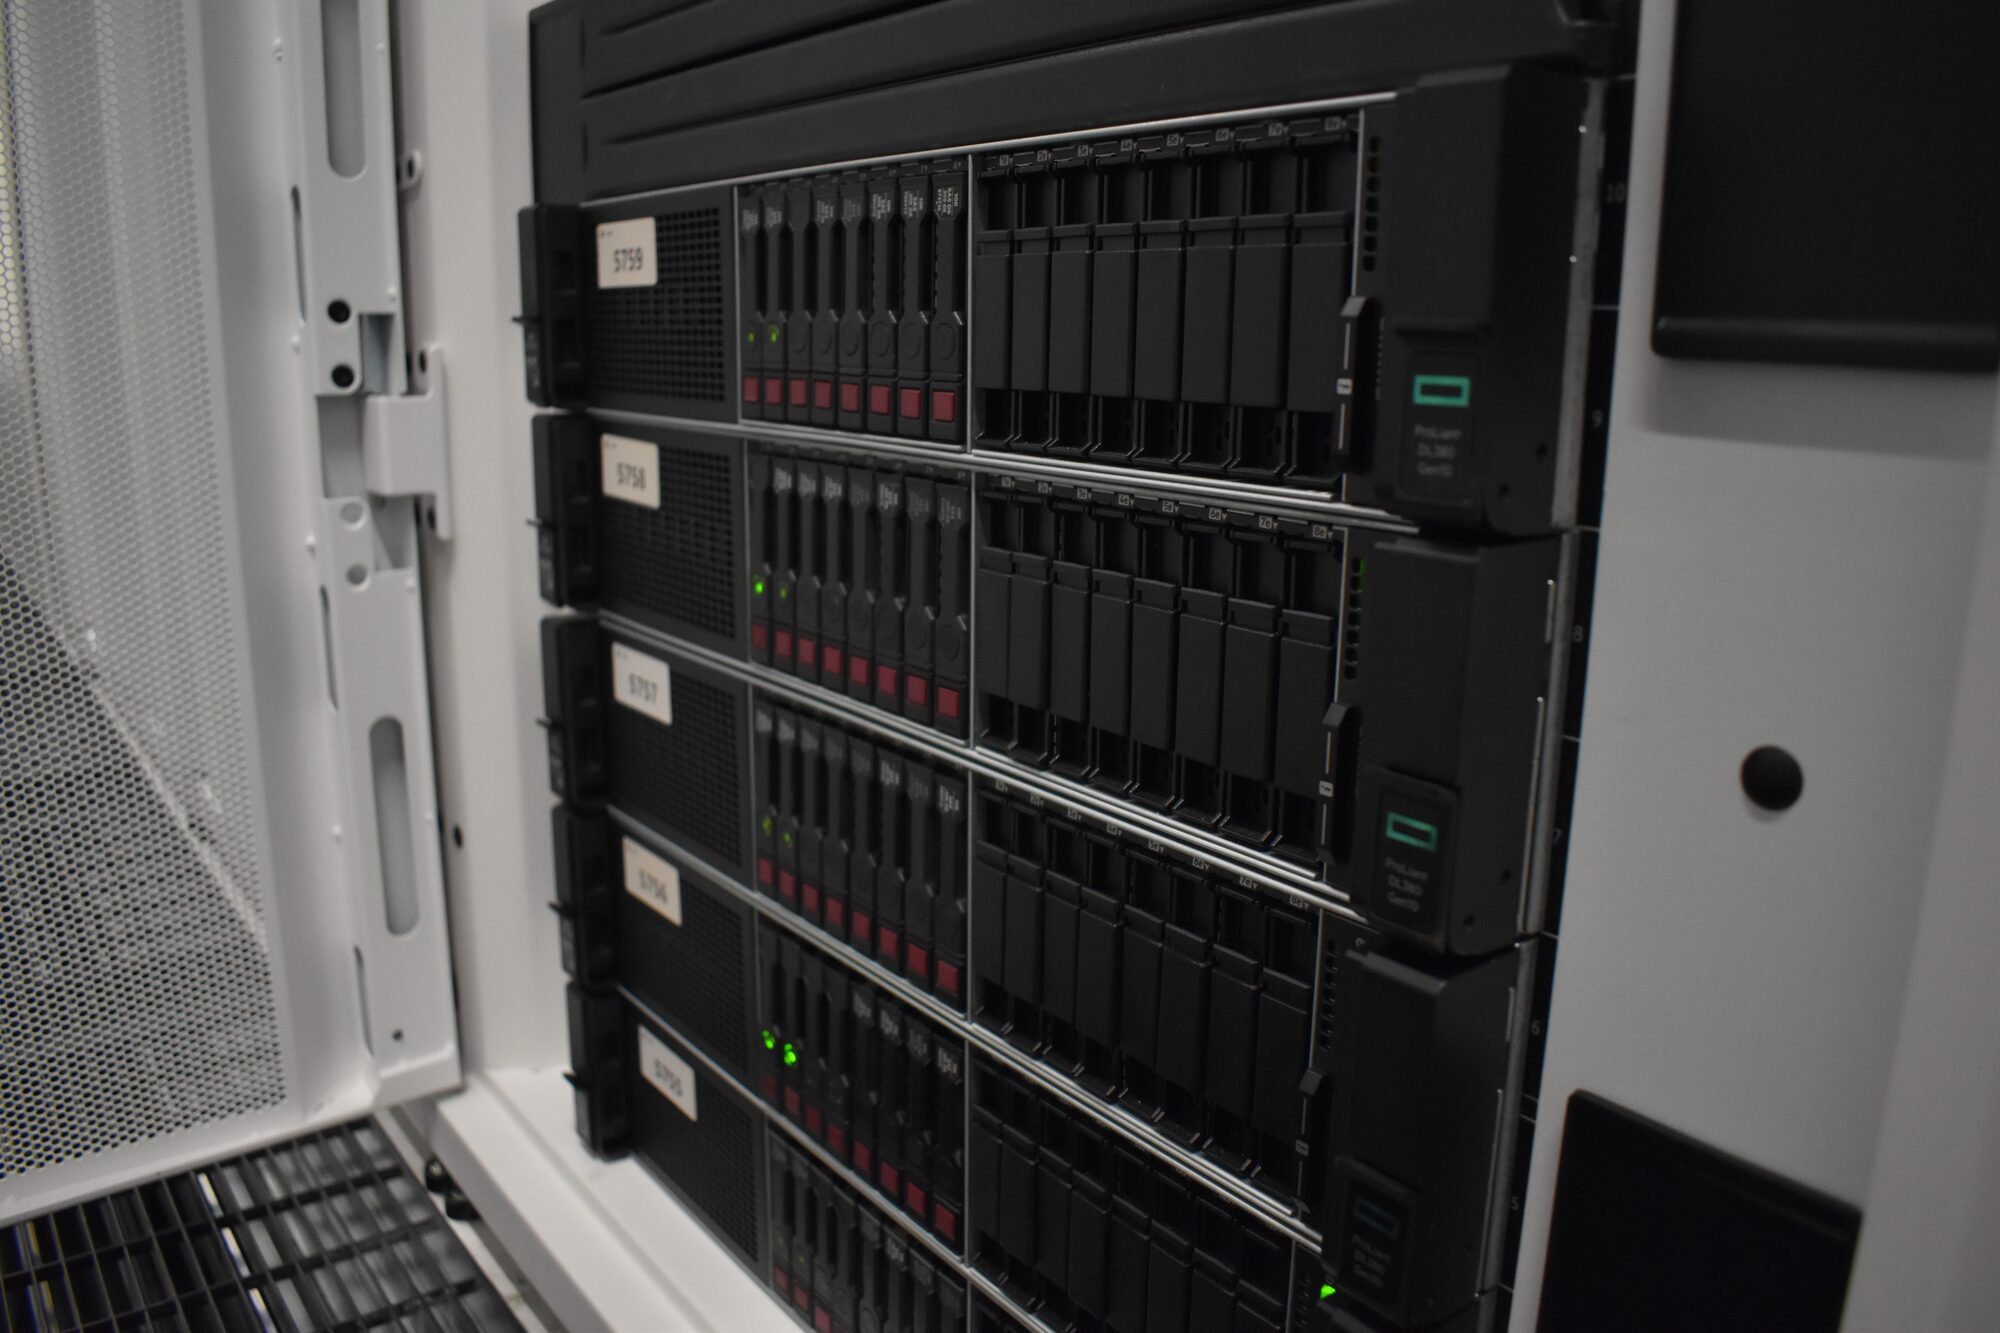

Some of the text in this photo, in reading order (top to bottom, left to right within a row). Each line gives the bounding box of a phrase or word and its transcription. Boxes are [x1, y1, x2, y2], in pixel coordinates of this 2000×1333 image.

[1607, 183, 1625, 203] 10
[1591, 408, 1603, 429] 9
[1573, 624, 1584, 643] 8
[1553, 828, 1562, 844] 7
[1530, 1019, 1540, 1035] 6
